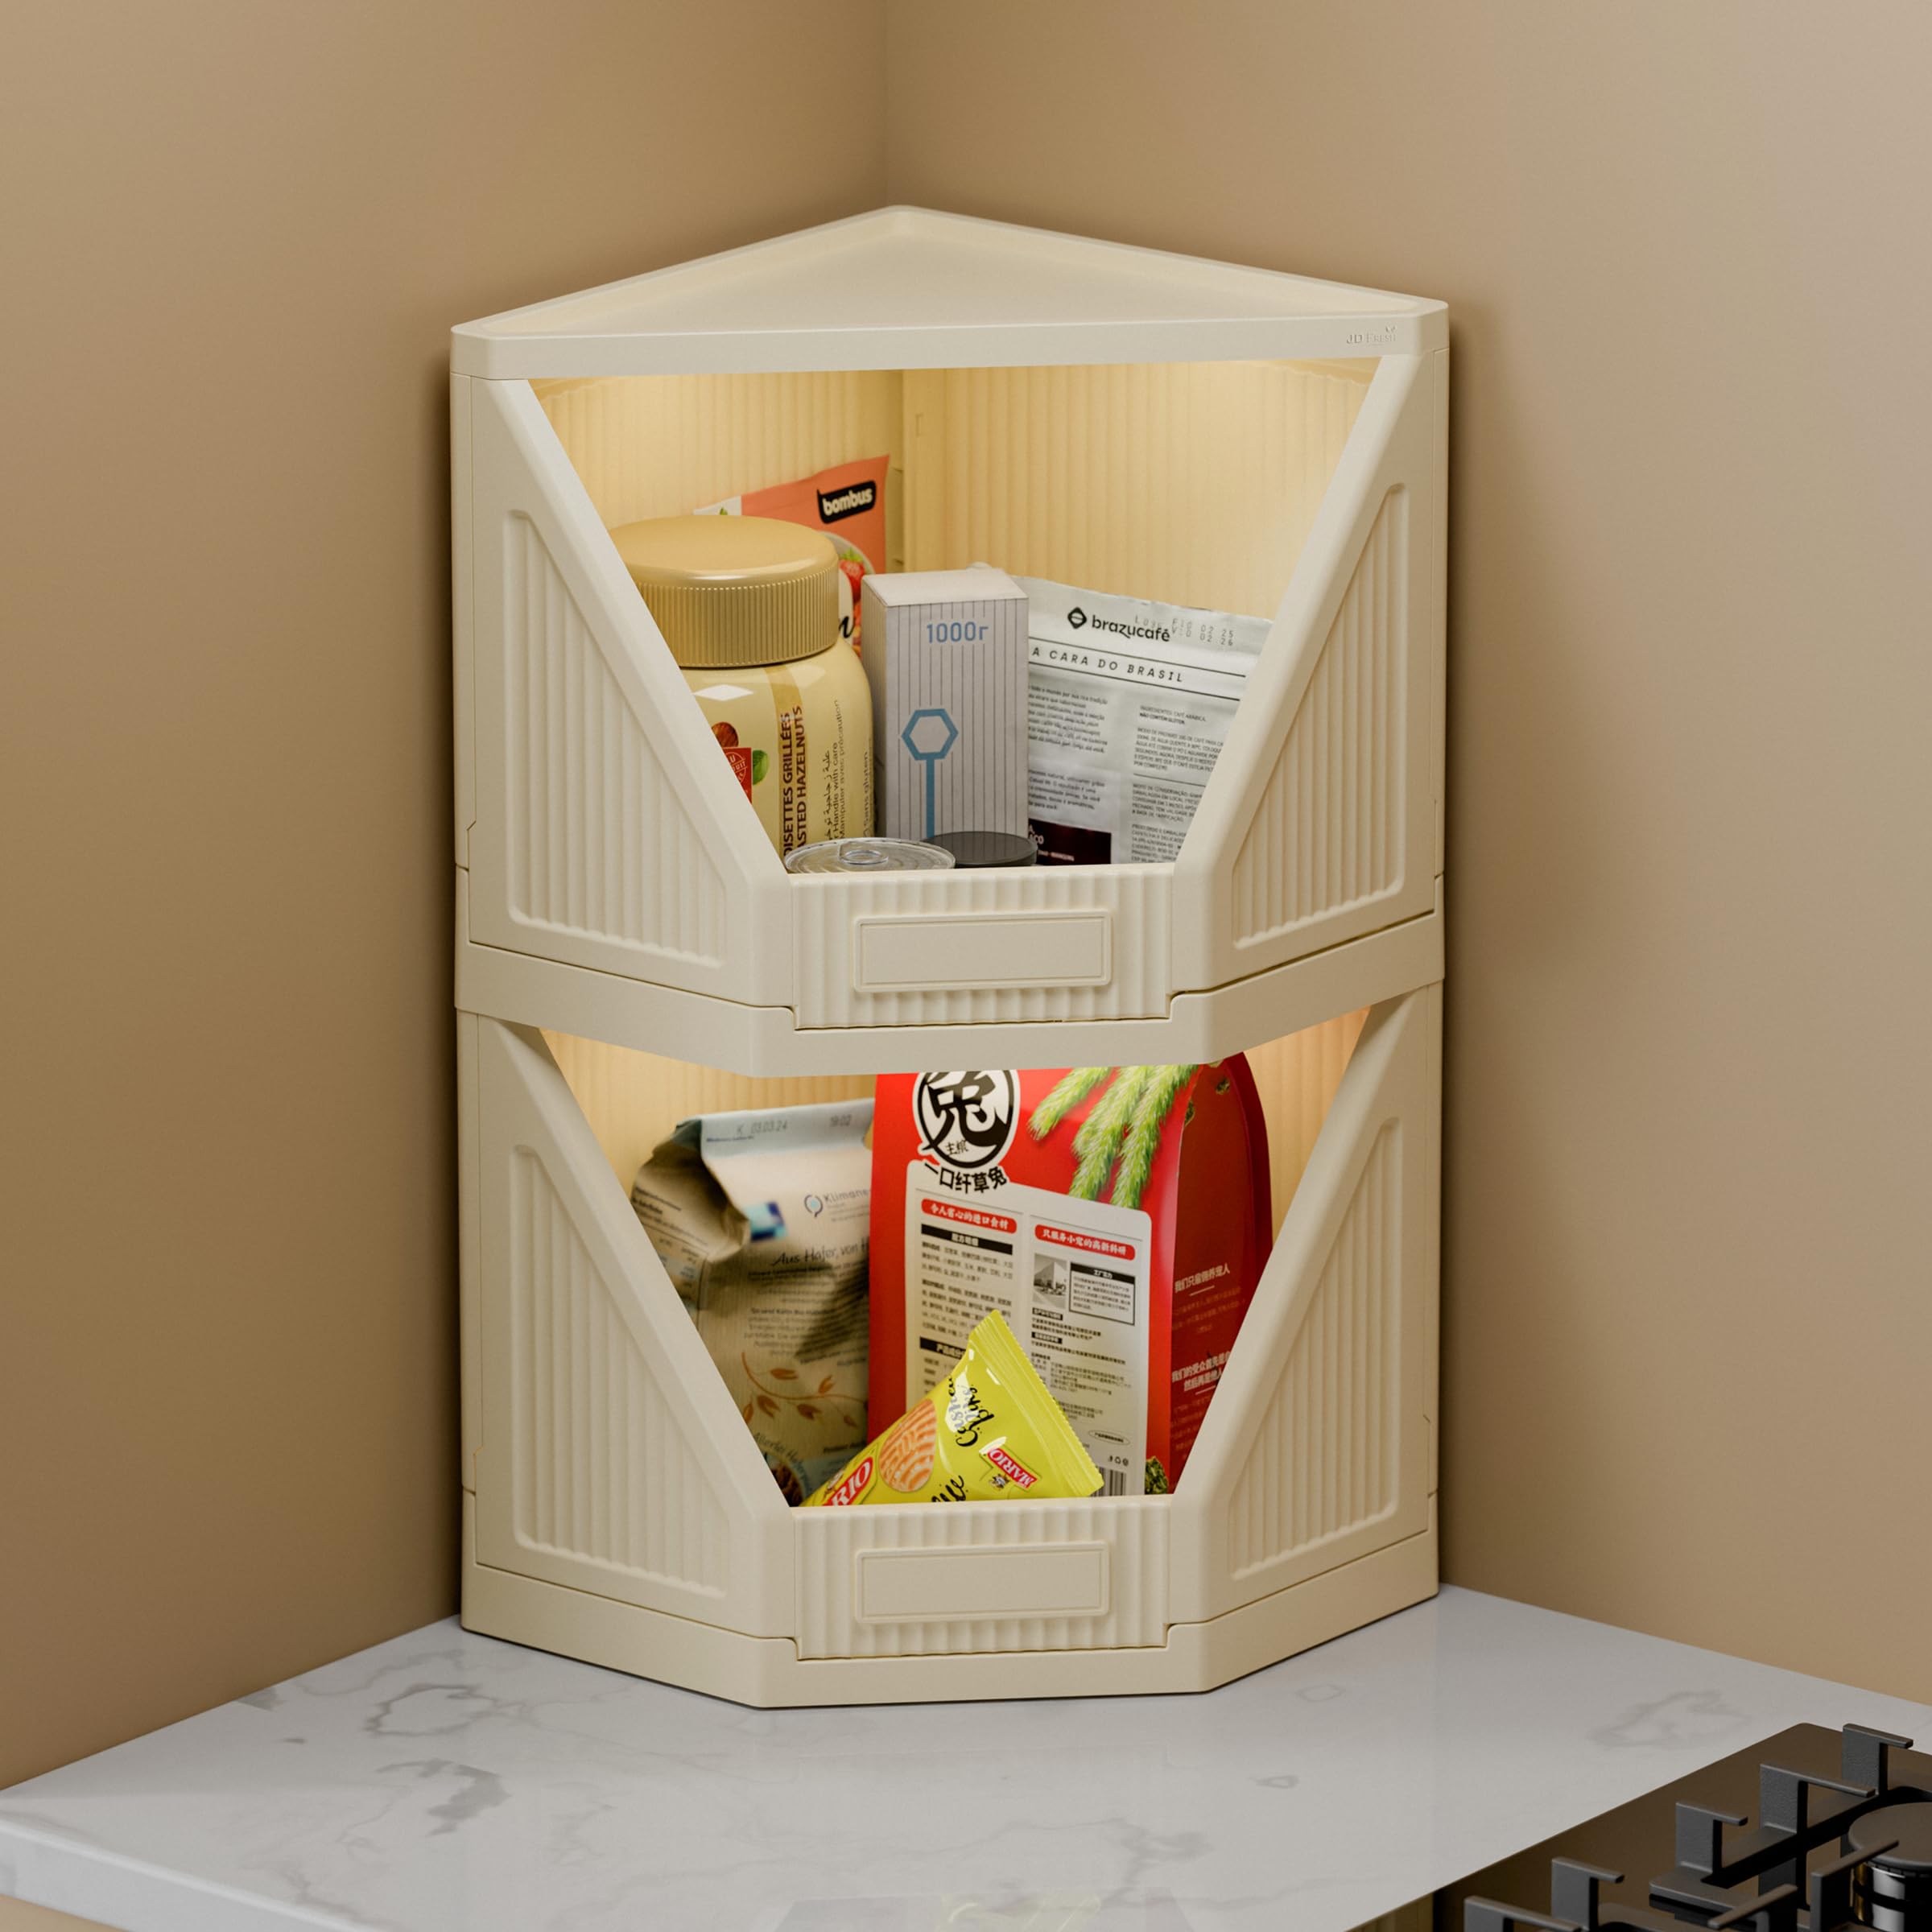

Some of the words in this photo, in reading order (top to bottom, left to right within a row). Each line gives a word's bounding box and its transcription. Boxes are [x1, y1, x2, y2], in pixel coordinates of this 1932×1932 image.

[822, 488, 873, 516] bombus
[1092, 614, 1170, 642] brazucafé
[1032, 647, 1039, 657] A
[1050, 650, 1088, 666] CARA
[1098, 659, 1118, 671] DO
[1127, 664, 1183, 683] BRASIL
[781, 712, 793, 784] GRILLÉES
[793, 706, 806, 797] HAZELNUTS
[783, 787, 793, 857] OISETTES
[797, 802, 807, 848] ASTED
[824, 1189, 870, 1203] Klimane
[925, 1163, 1007, 1193] 一口纤草兔
[827, 1461, 871, 1506] RIO
[989, 1449, 1037, 1488] MARIO
